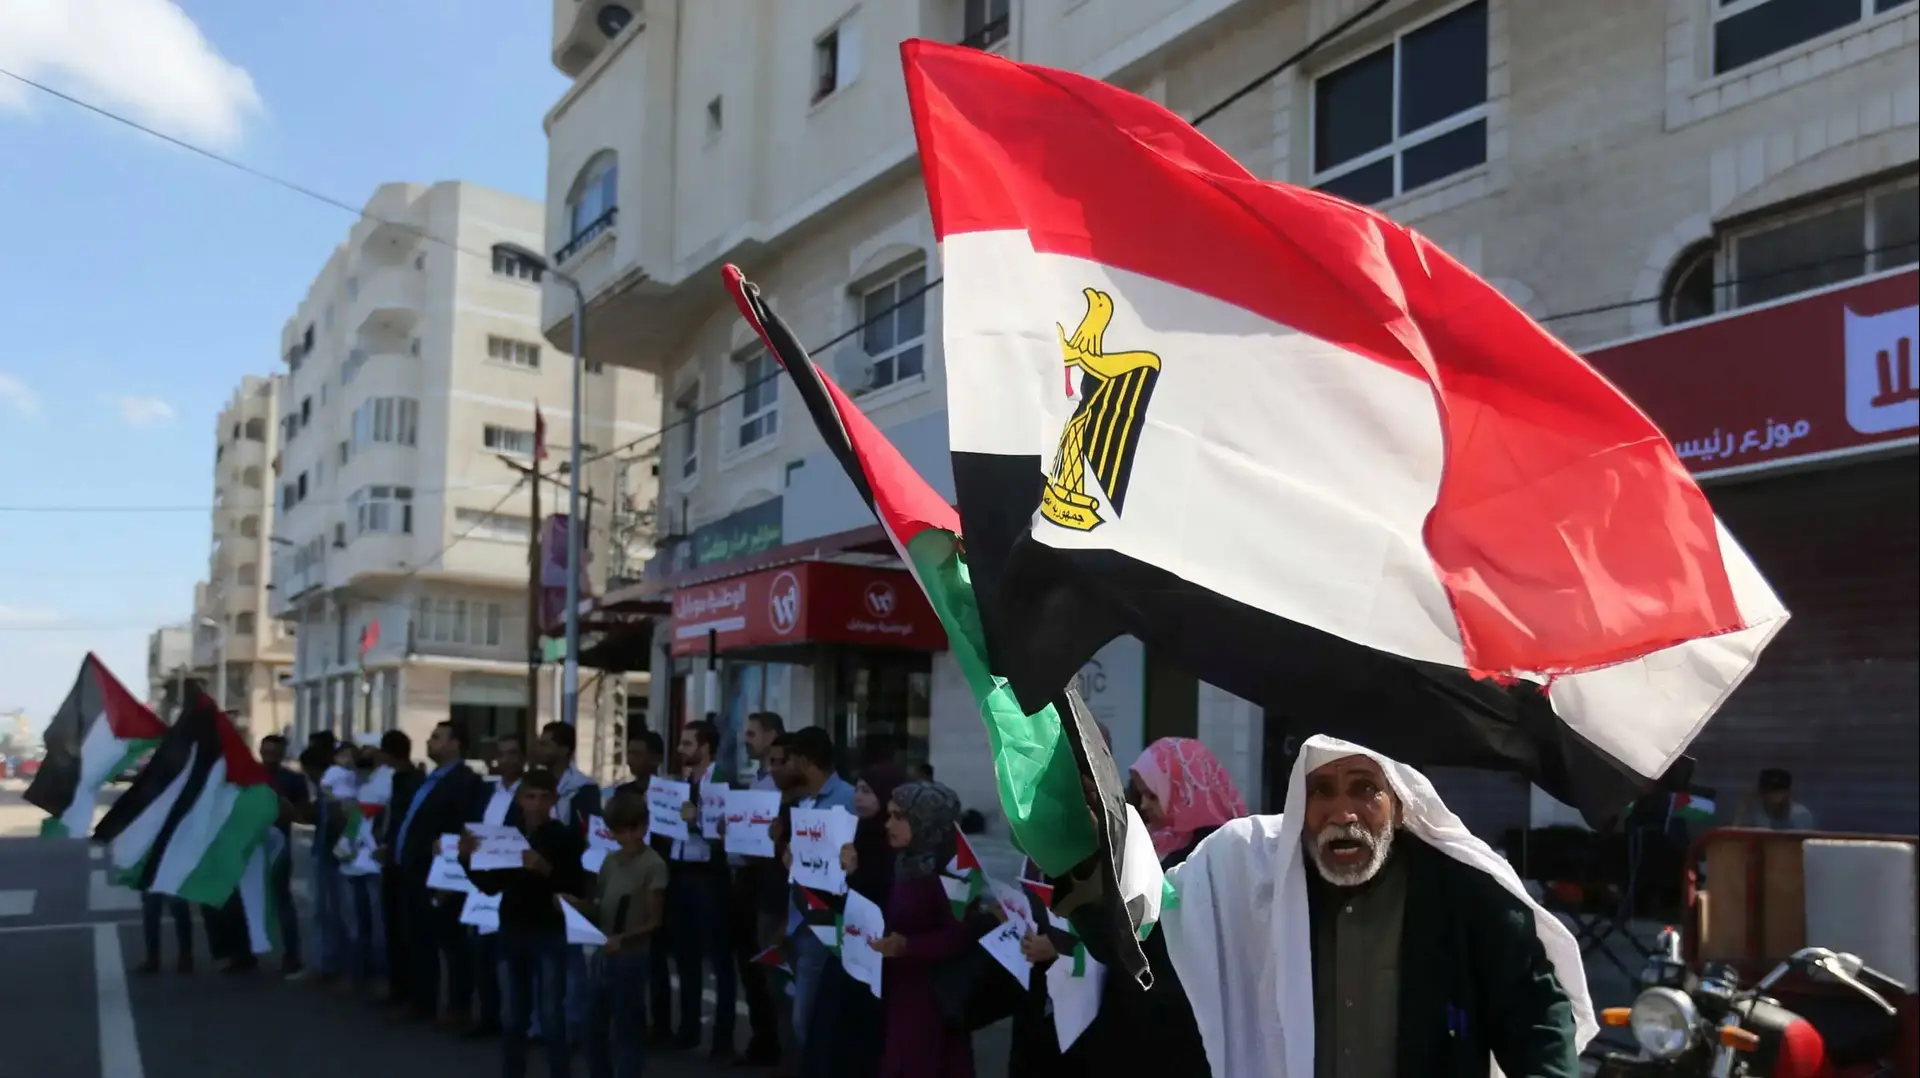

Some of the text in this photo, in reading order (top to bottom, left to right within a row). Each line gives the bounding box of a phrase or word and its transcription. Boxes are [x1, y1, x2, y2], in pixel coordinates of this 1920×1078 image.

[1675, 418, 1810, 460] موزع رئيس
[1053, 504, 1085, 525] جمهورية
